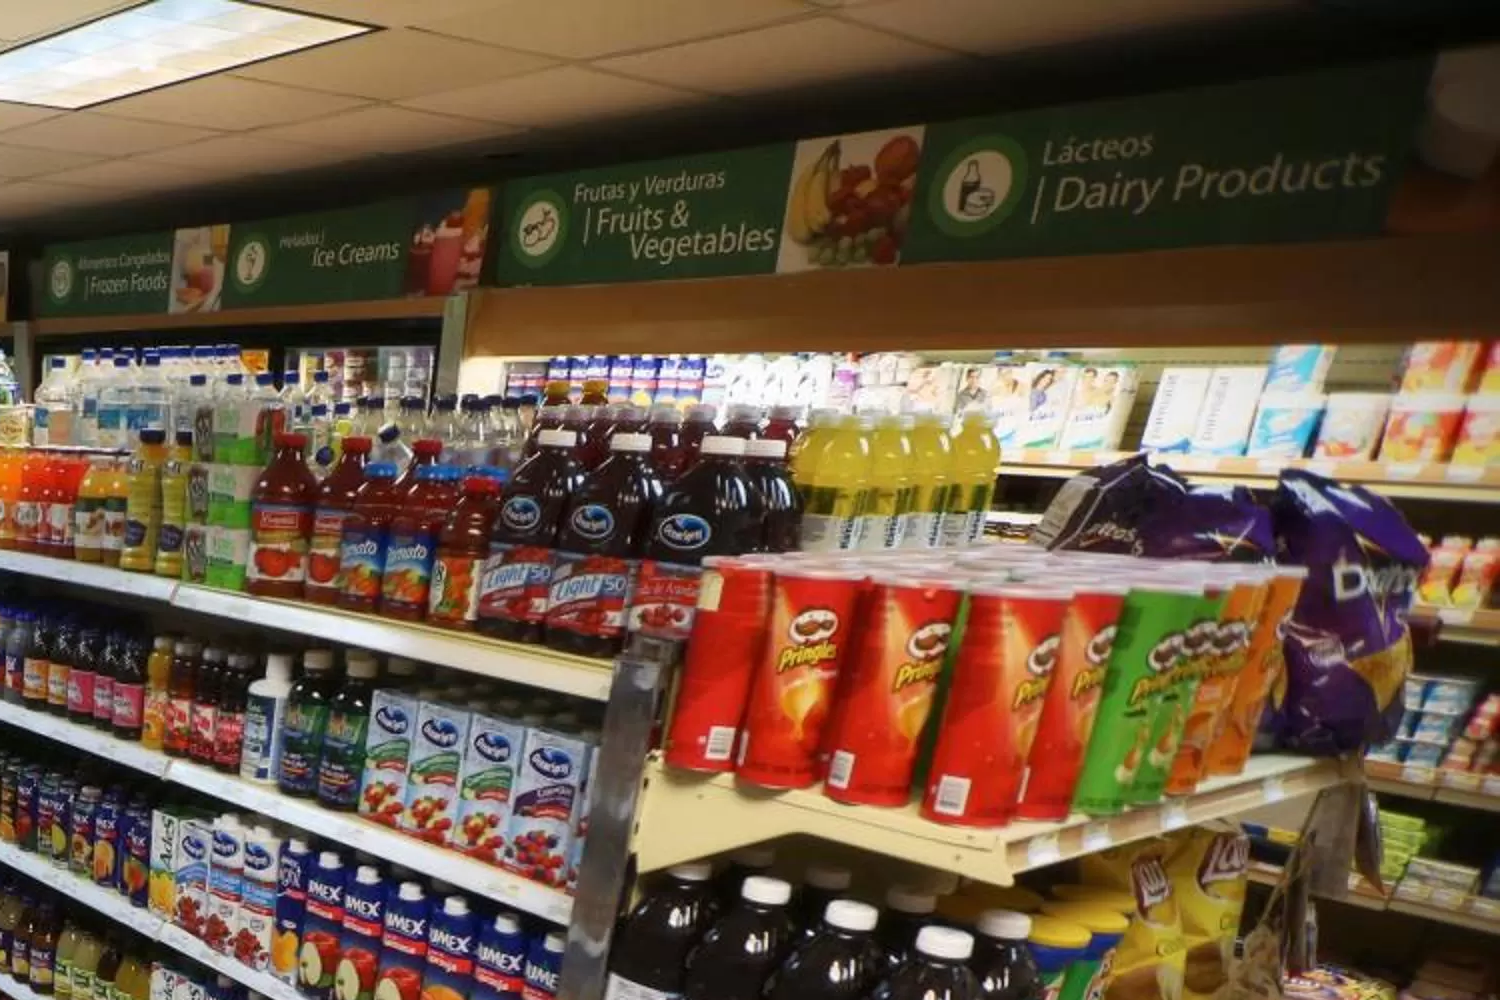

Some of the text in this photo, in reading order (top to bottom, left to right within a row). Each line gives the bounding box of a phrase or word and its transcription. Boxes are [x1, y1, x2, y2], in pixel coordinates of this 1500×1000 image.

[1043, 132, 1155, 167] Lácteos
[573, 169, 727, 204] Frutas y Verduras
[1053, 151, 1387, 216] Dairy Products
[596, 199, 690, 236] Fruits &
[311, 242, 400, 268] Ice Creams
[630, 222, 776, 266] Vegetables
[92, 270, 170, 295] Frozen Foods
[603, 574, 628, 593] 50
[777, 642, 837, 675] Pringles
